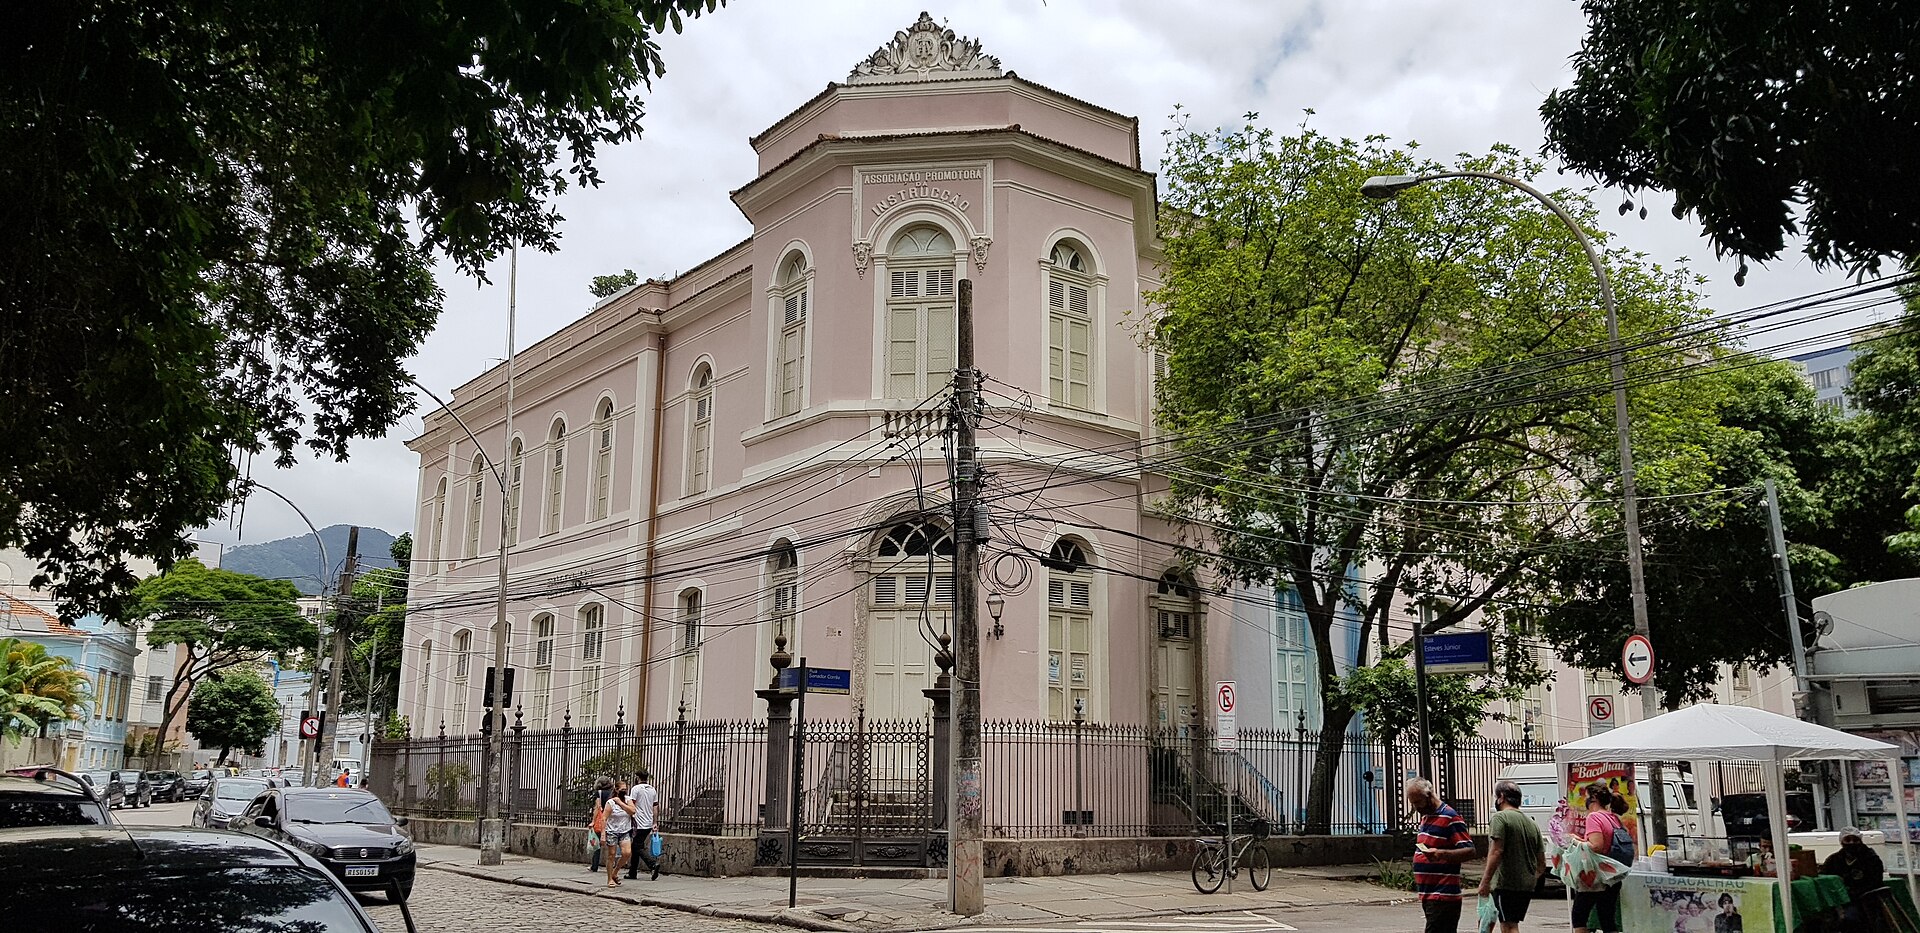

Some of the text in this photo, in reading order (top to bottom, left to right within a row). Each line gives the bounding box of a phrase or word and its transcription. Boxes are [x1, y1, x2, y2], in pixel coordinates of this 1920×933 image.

[925, 169, 981, 181] PROMOTORA
[871, 187, 970, 216] INSTRUCÇÃO
[1444, 643, 1461, 651] Júnior
[1578, 762, 1625, 778] Bacalhau
[1645, 876, 1664, 884] DO
[1668, 877, 1745, 888] BACALHAU
